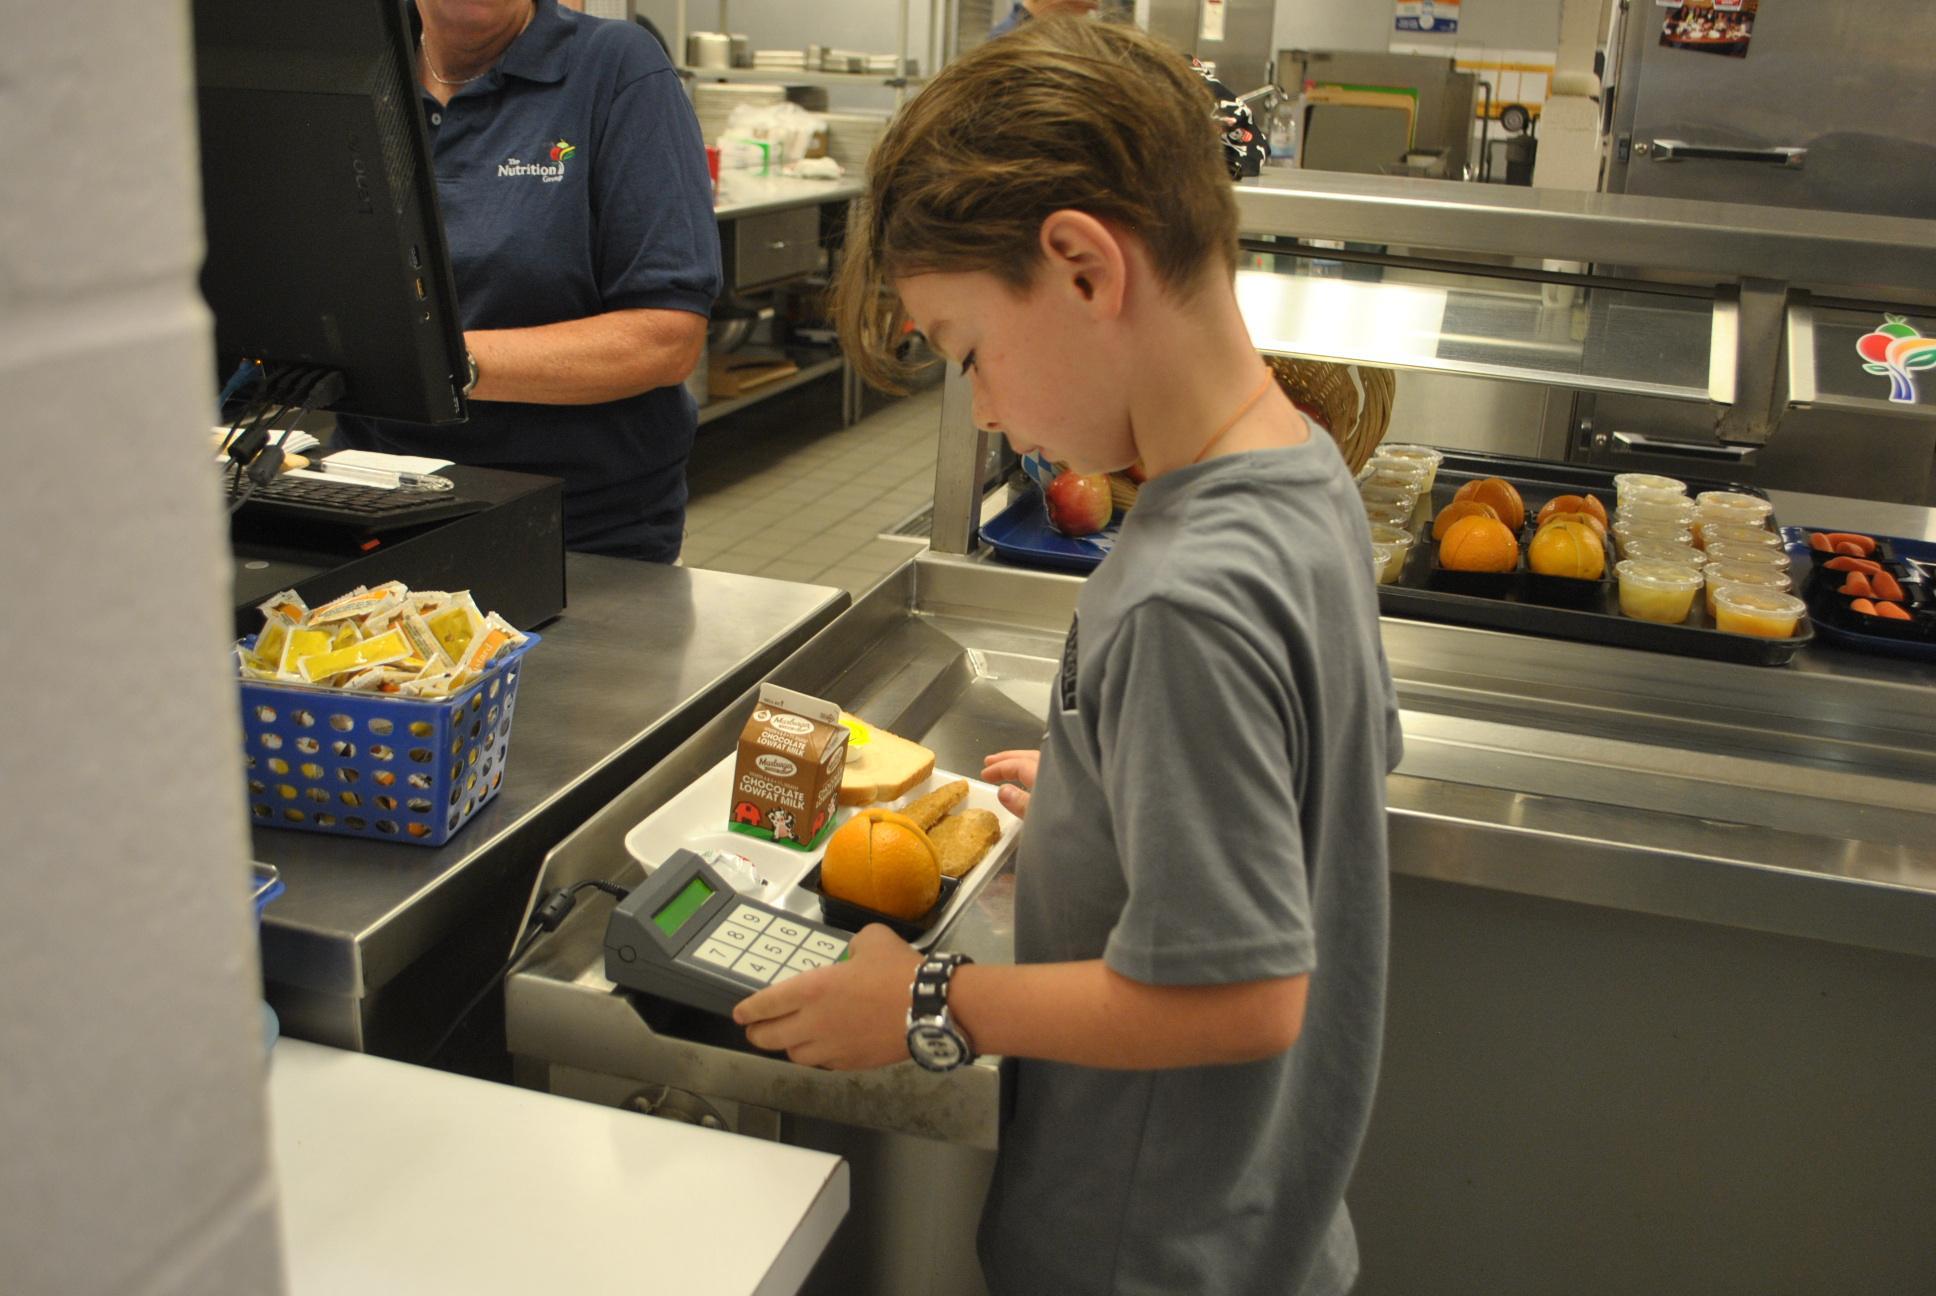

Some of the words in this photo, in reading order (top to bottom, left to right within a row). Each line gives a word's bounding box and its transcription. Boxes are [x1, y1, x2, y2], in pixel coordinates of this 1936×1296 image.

[498, 163, 557, 176] Nutrition
[757, 736, 786, 751] LOWFAT
[786, 744, 806, 757] MILK
[761, 731, 806, 750] CHOCOLATE
[742, 774, 805, 801] CHOCOLATE
[739, 782, 779, 802] LOWFAT
[780, 796, 806, 810] MILK
[727, 930, 745, 940] 8
[764, 943, 783, 954] 5
[816, 939, 835, 951] 3
[709, 947, 727, 958] 7
[750, 962, 766, 972] 4
[802, 957, 821, 969] 2
